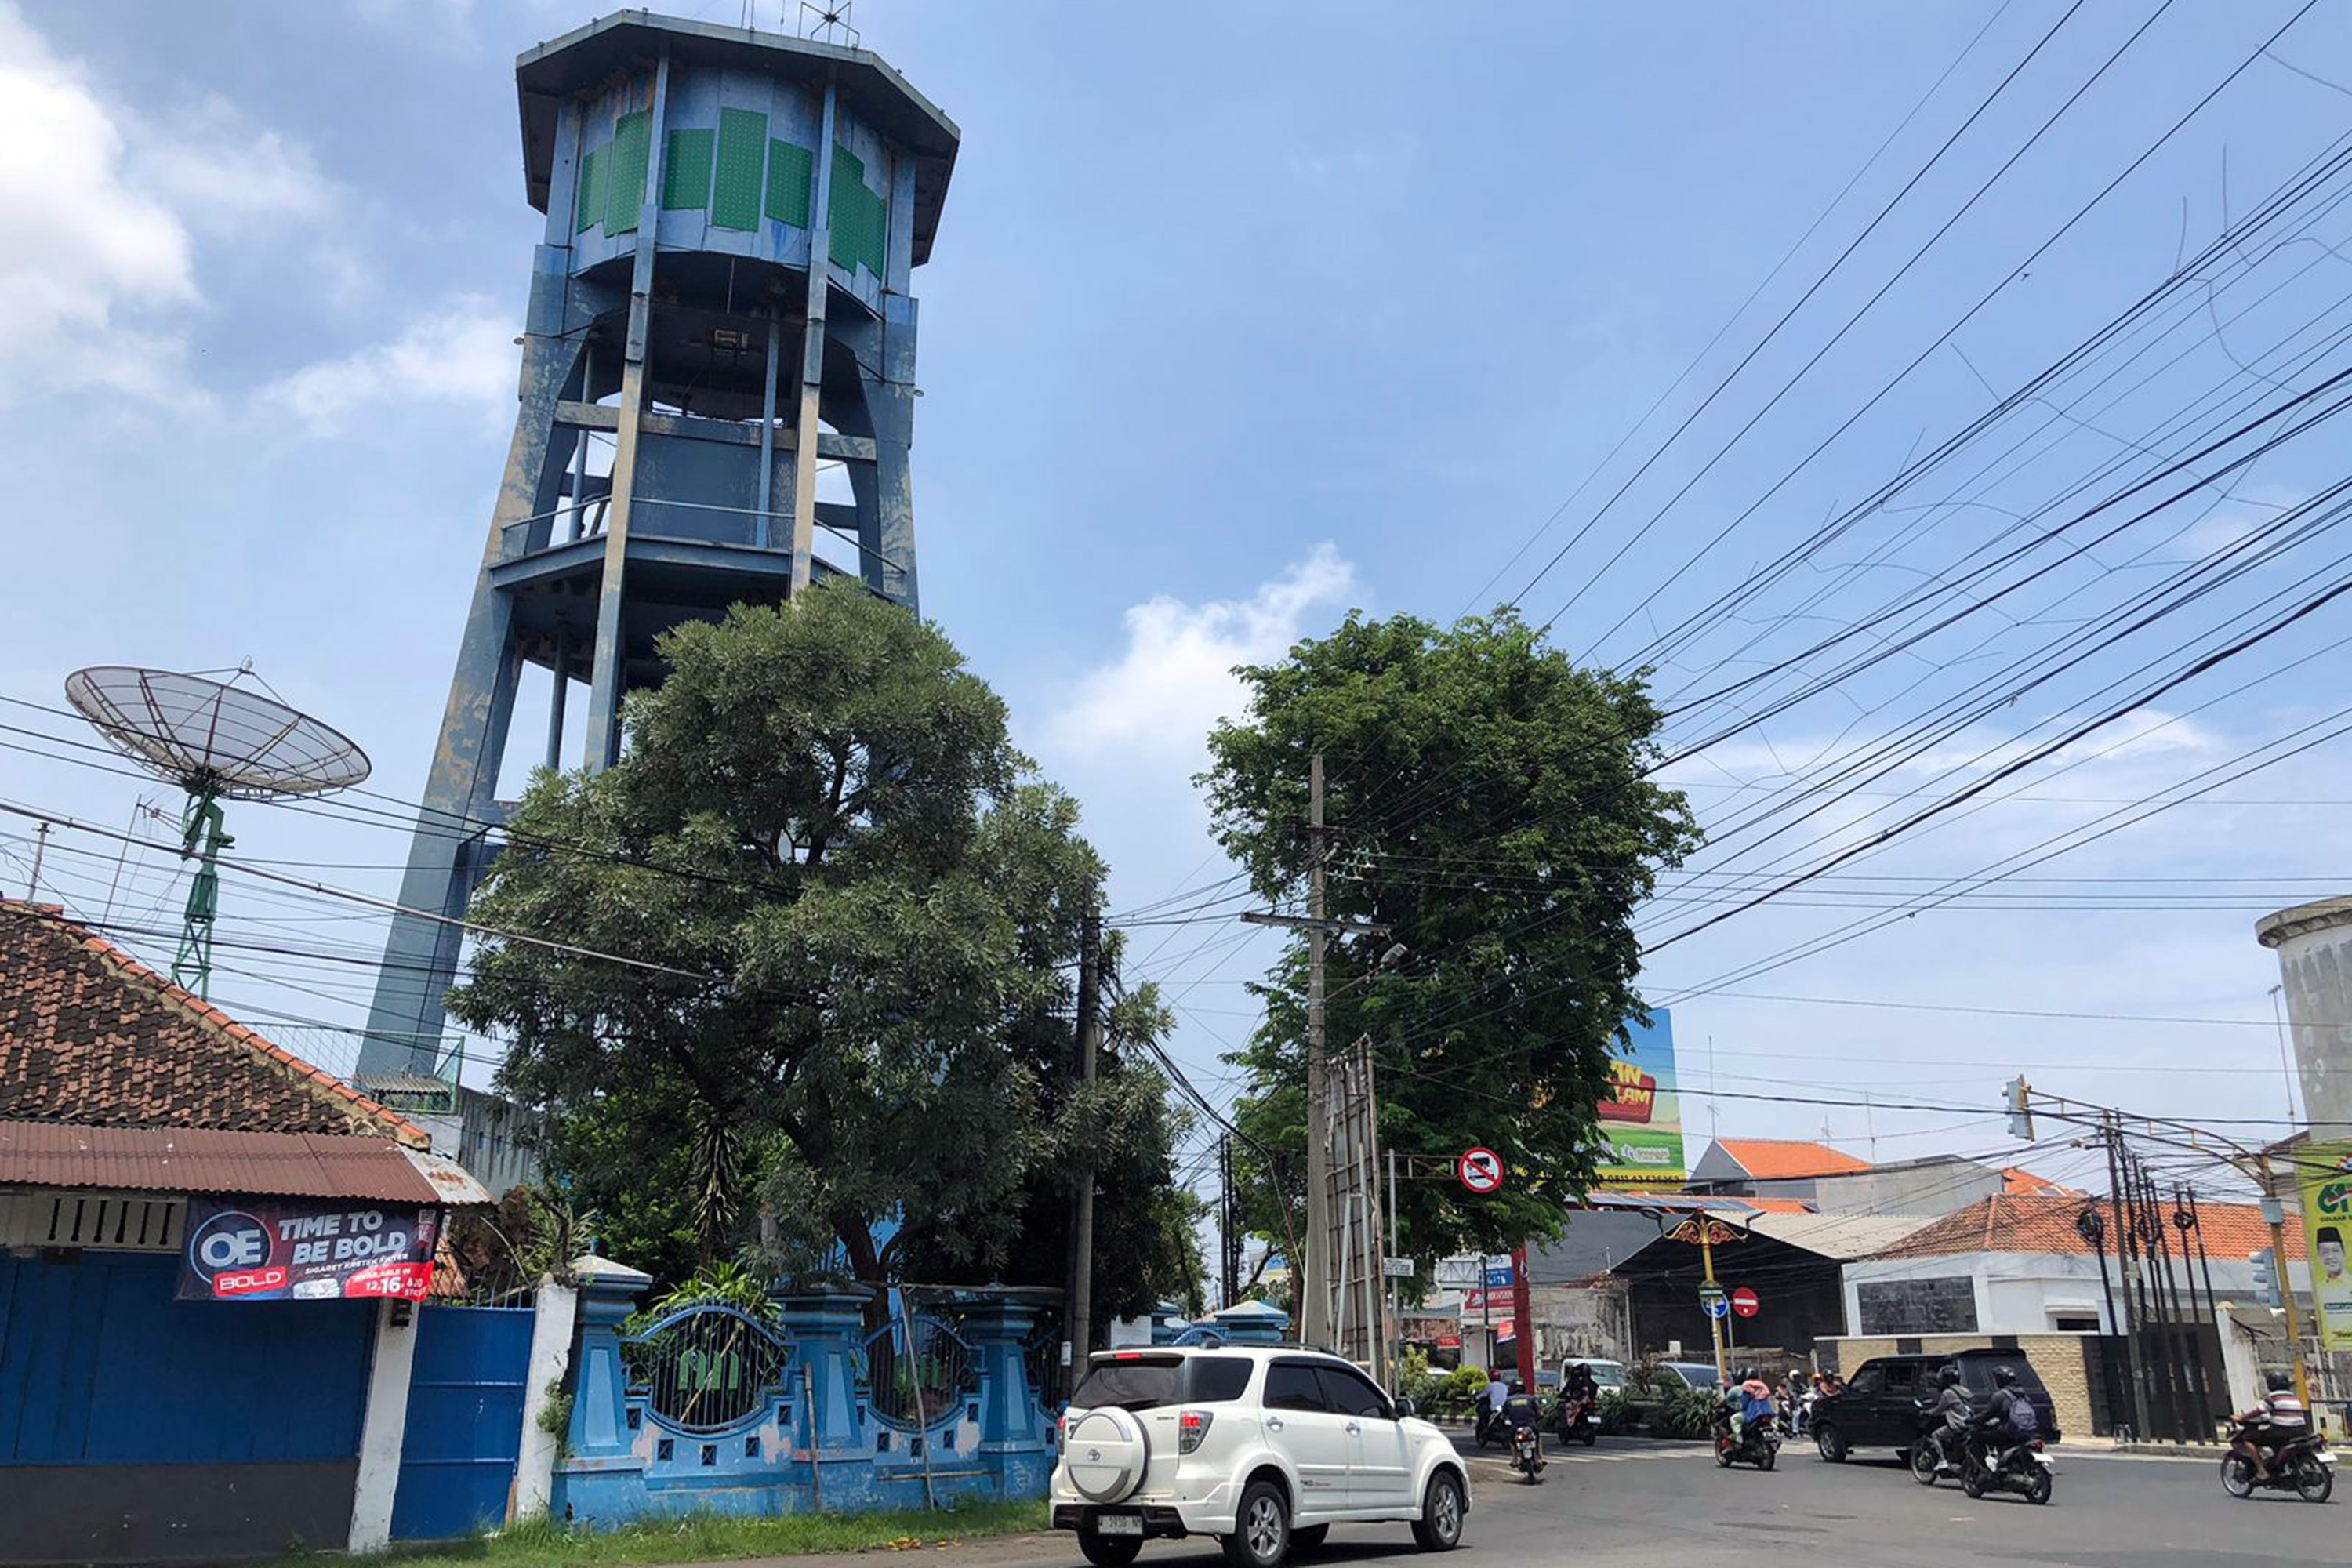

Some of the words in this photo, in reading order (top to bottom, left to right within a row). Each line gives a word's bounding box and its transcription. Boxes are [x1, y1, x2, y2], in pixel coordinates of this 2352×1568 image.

[278, 1214, 342, 1241] TIME
[348, 1210, 383, 1232] TO
[201, 1229, 262, 1267] OE
[292, 1240, 330, 1265] BE
[335, 1231, 406, 1260] BOLD
[219, 1271, 282, 1290] BOLD
